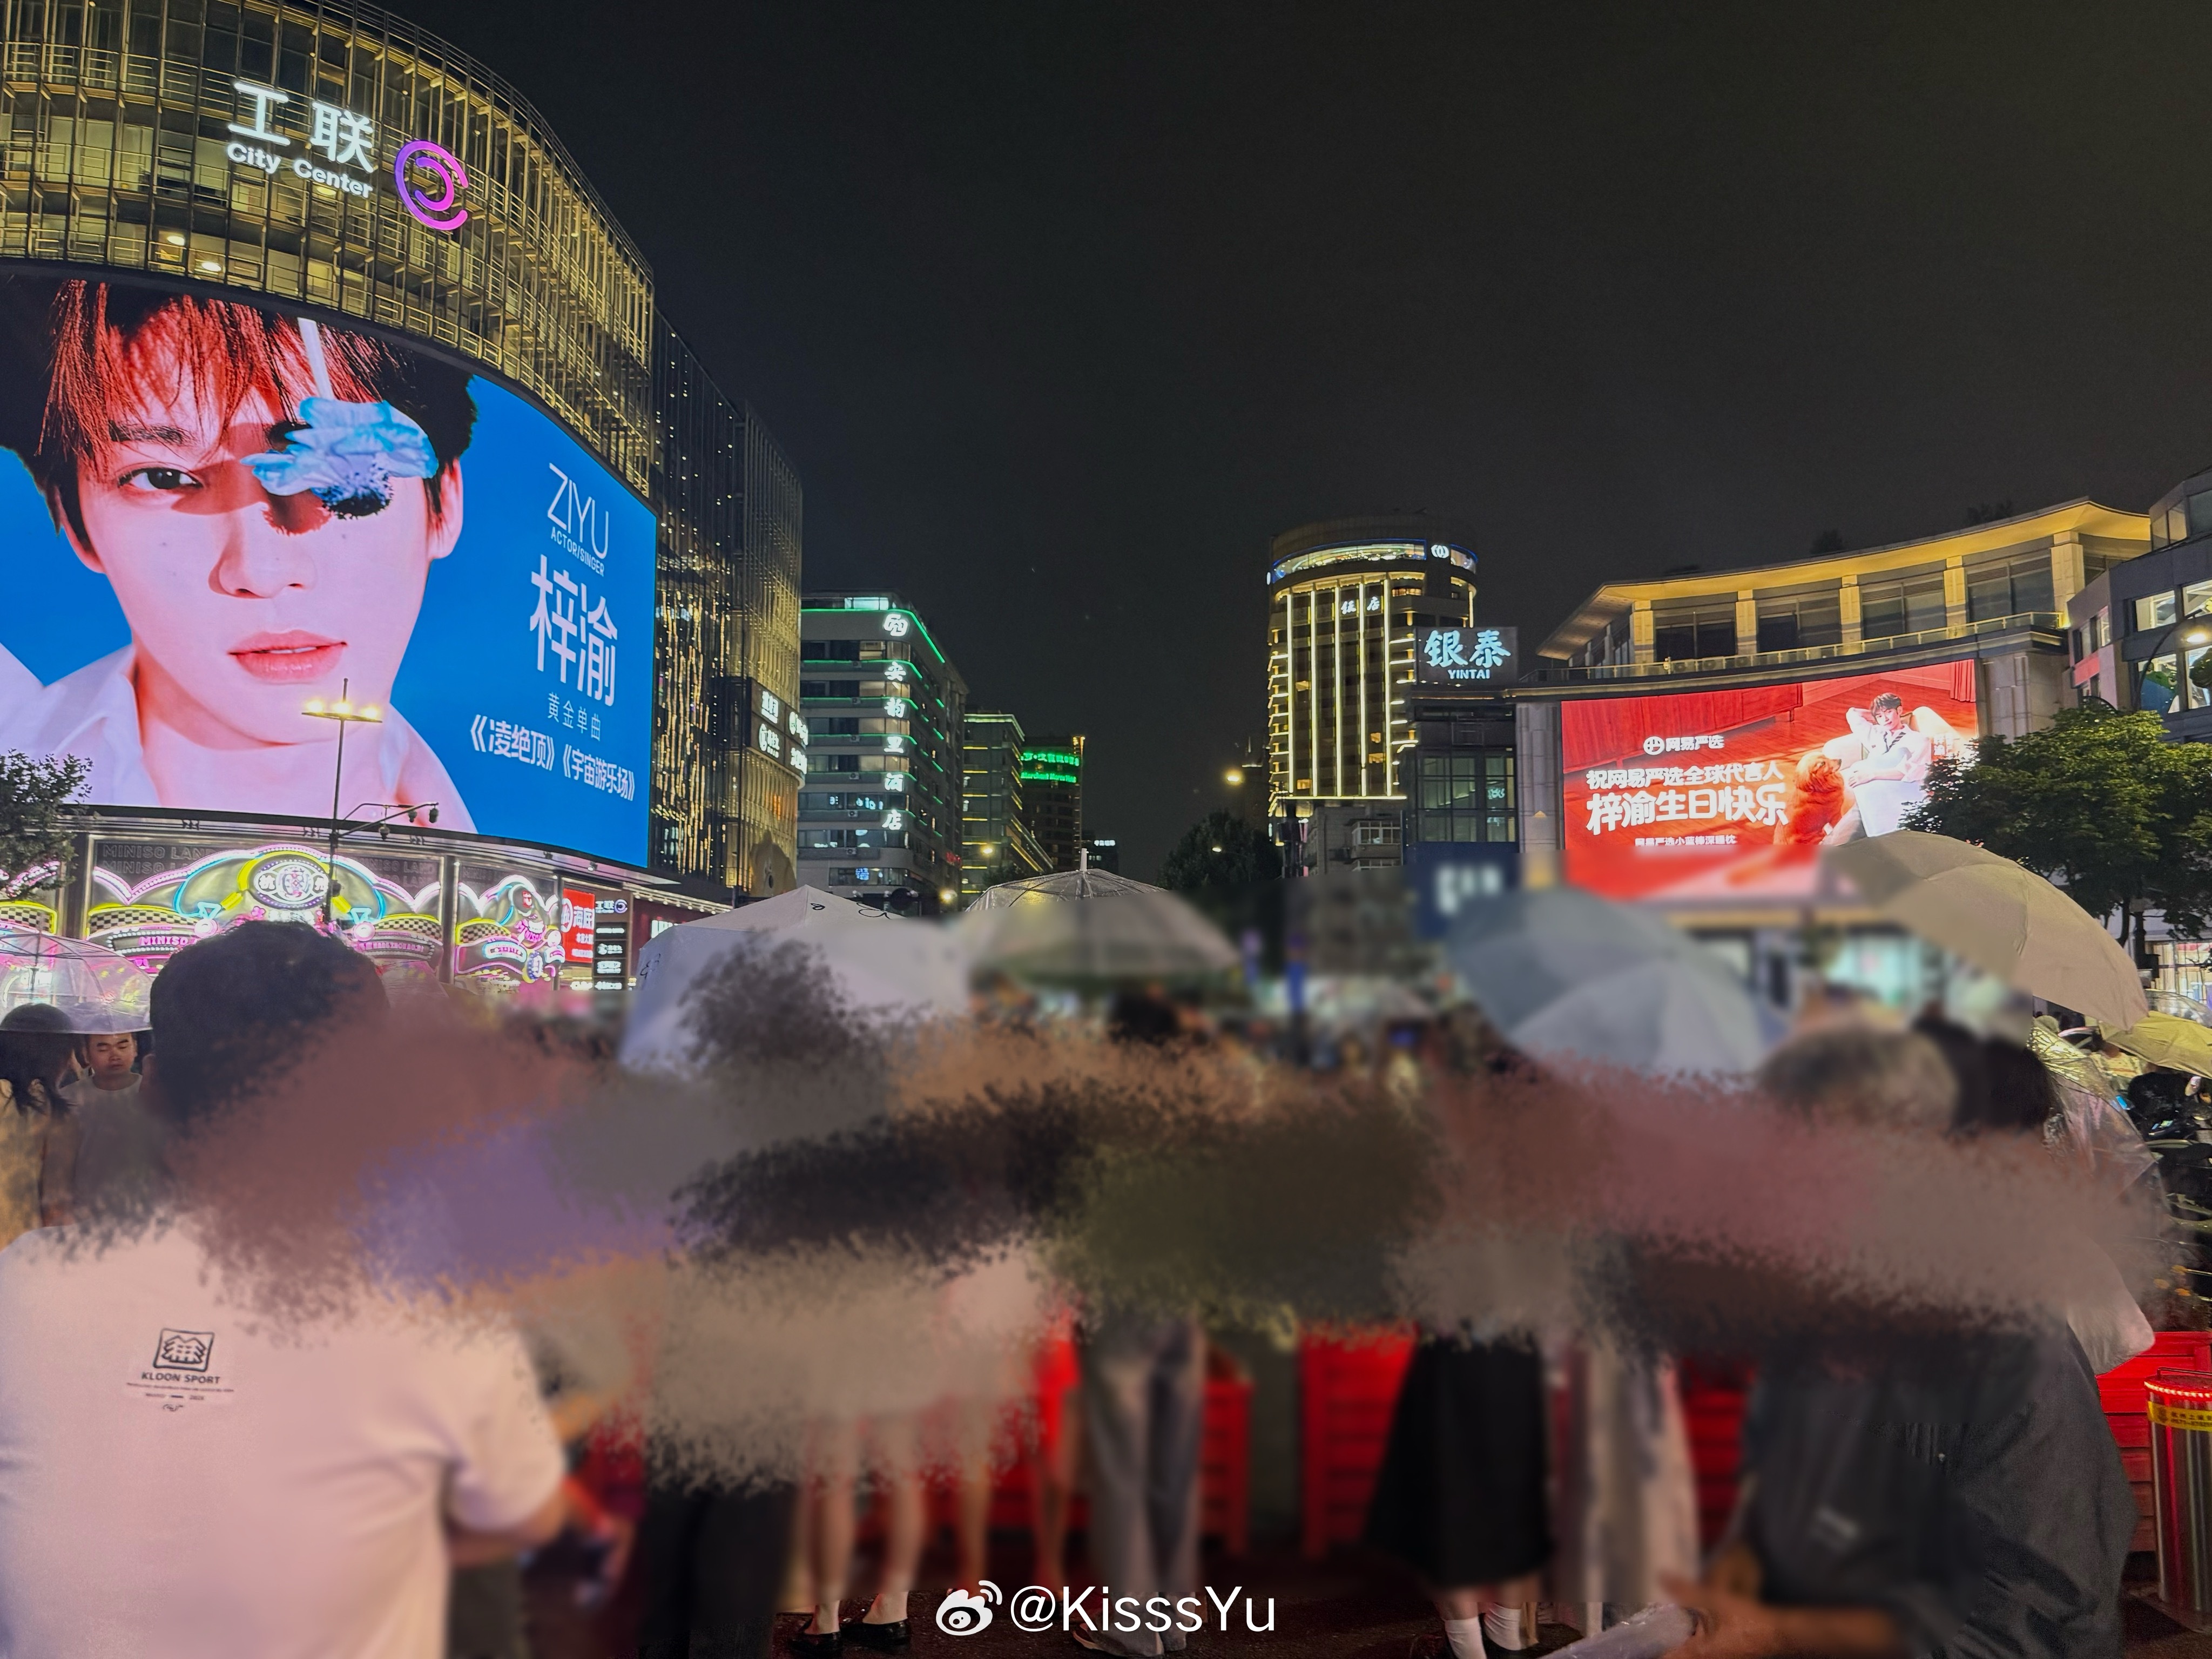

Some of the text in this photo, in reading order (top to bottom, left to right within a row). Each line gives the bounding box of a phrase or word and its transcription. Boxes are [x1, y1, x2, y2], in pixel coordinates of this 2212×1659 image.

[227, 82, 375, 173] 工联
[227, 142, 374, 199] City Center
[547, 462, 609, 559] ZIYU
[551, 526, 605, 577] ACTOR/SINGER
[529, 554, 618, 707] 梓渝
[1424, 629, 1511, 667] 银泰
[1447, 669, 1491, 679] YINTAI
[547, 692, 601, 741] 黄金单曲
[470, 714, 635, 801] 《凌绝顶》 《宇宙游乐场》
[1665, 734, 1725, 752] 网易严选
[1586, 760, 1784, 790] 祝网易严选全球代言人
[1586, 782, 1789, 835] 梓渝生日快乐
[103, 844, 165, 859] MINISO
[573, 906, 595, 930] 海底
[139, 935, 188, 946] MINISO
[184, 1374, 221, 1384] SPORT
